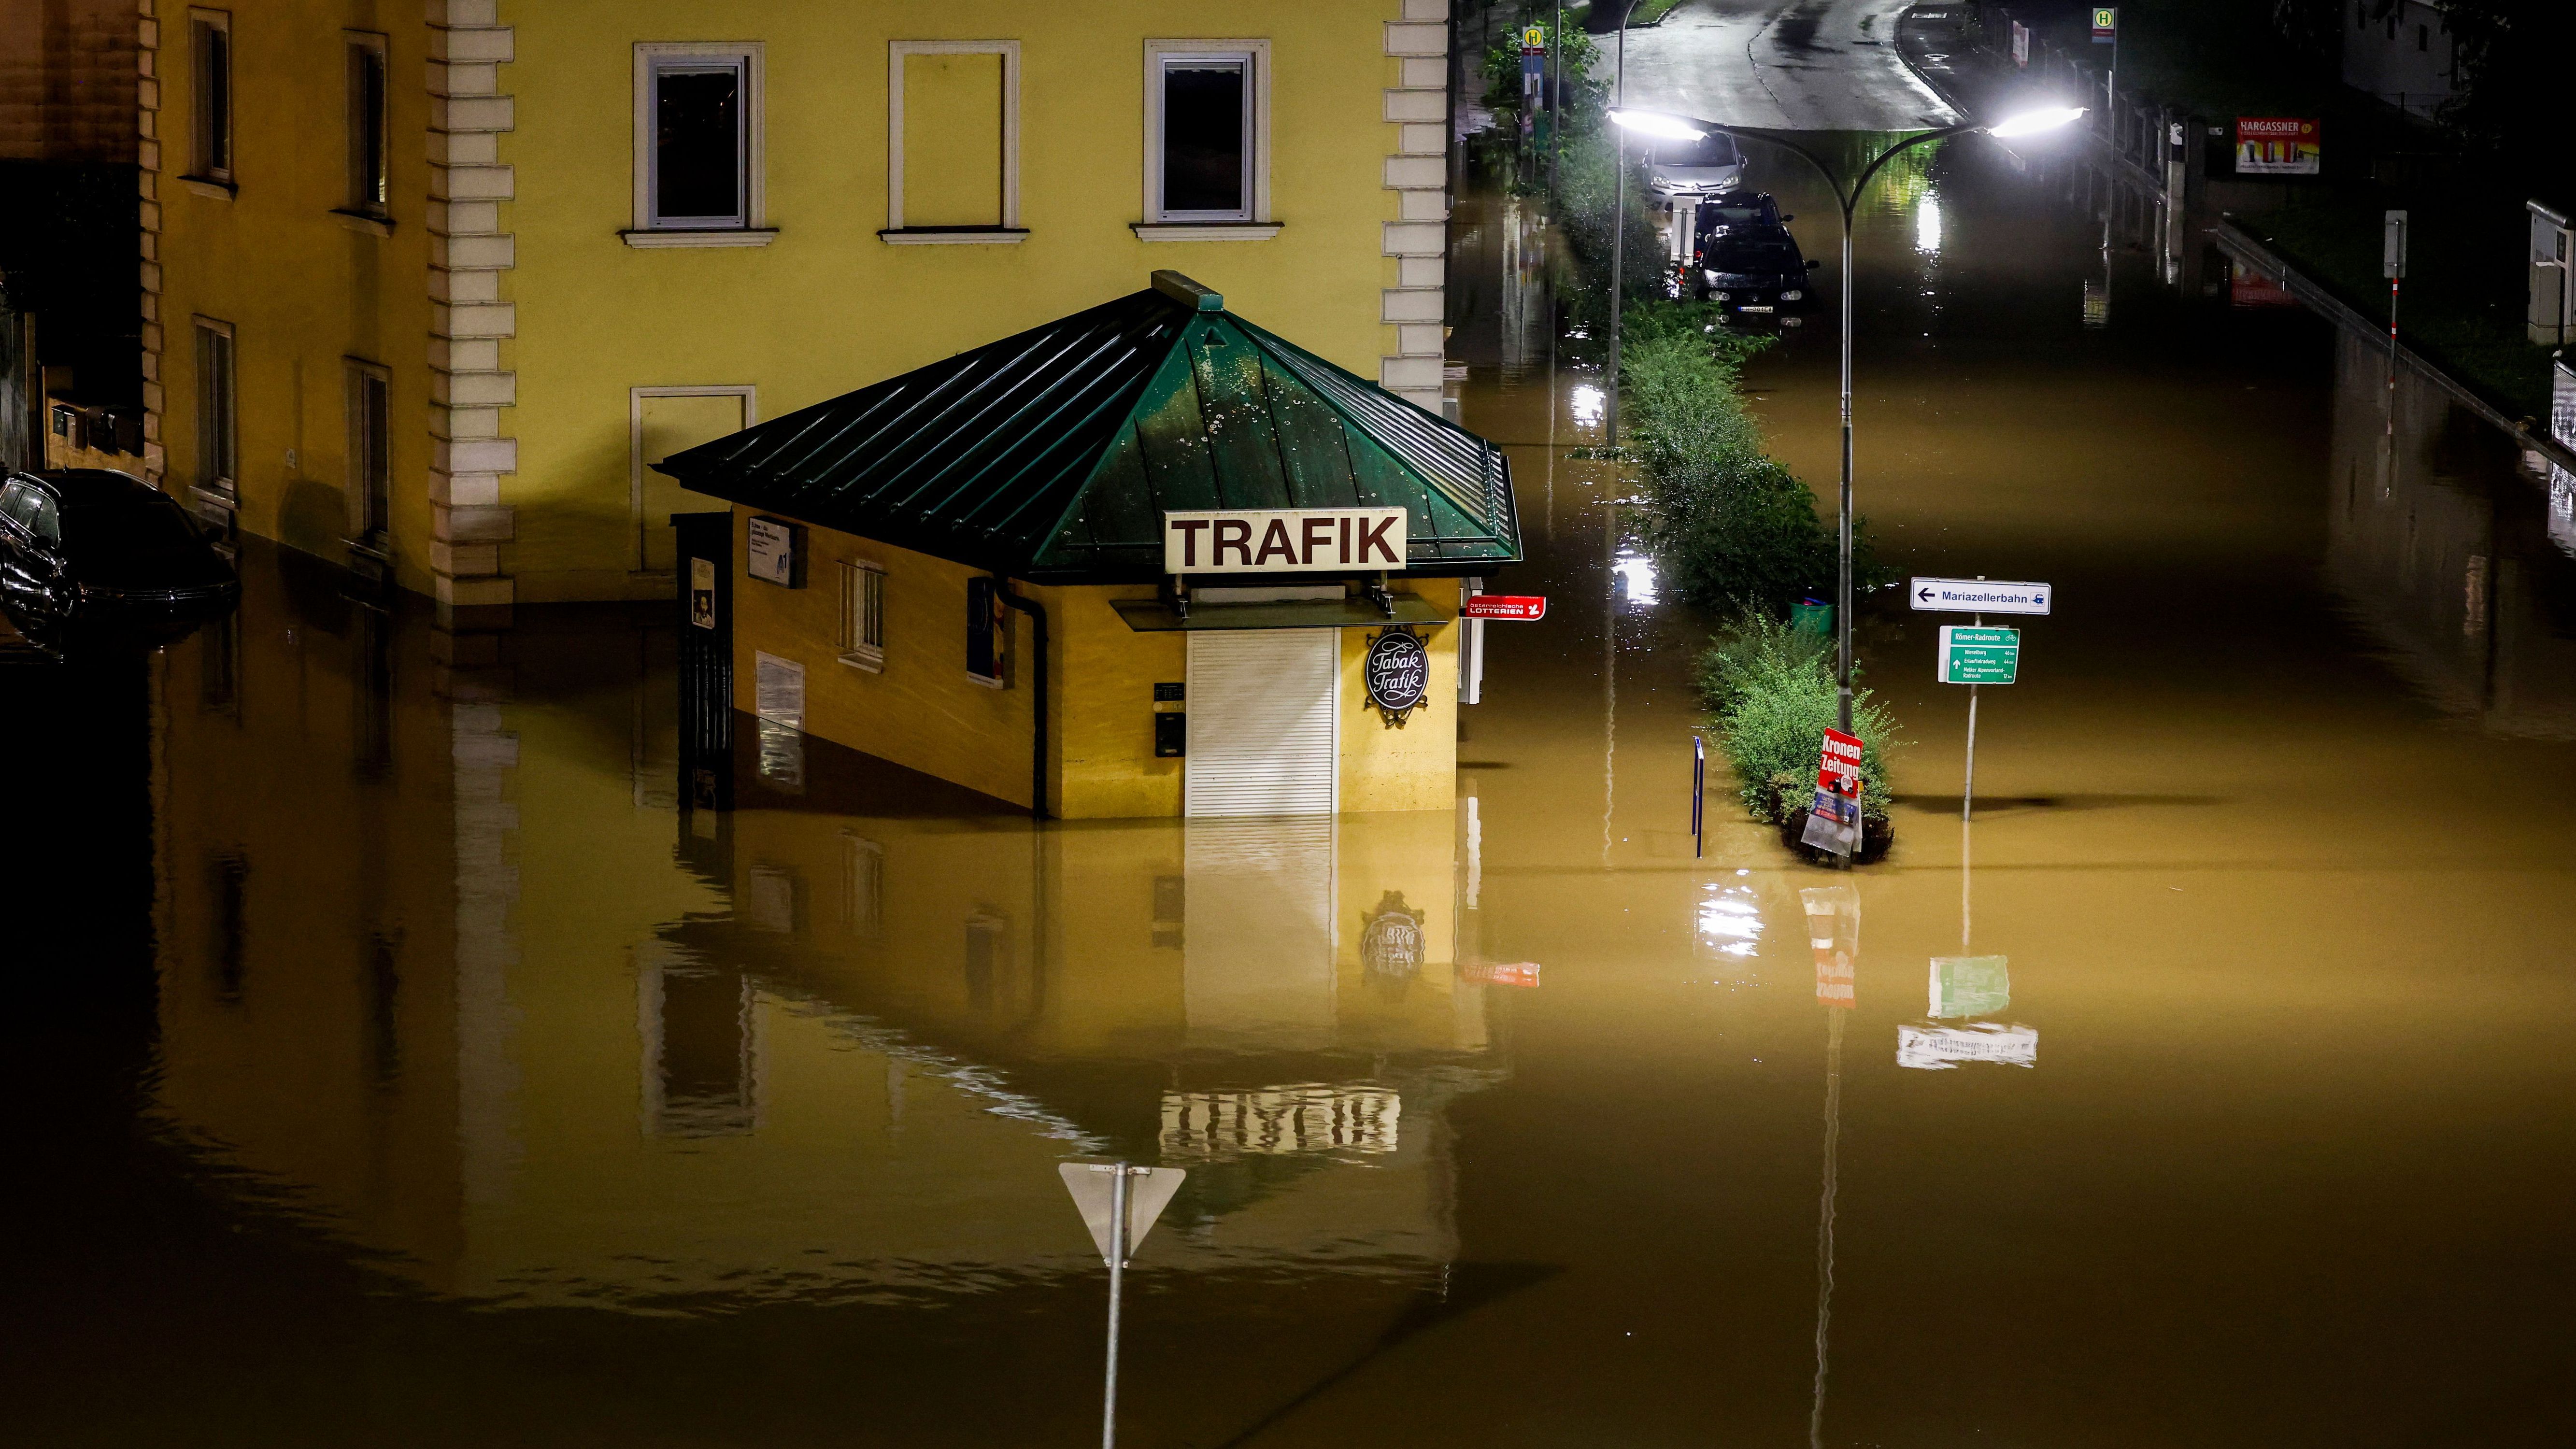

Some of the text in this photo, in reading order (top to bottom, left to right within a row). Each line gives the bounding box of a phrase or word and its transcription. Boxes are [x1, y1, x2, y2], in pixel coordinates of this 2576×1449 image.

[2100, 14, 2108, 24] H
[1529, 32, 1537, 43] H
[2241, 121, 2298, 131] HARGASSNER
[1171, 517, 1400, 567] TRAFIK
[777, 553, 787, 574] A1
[1942, 591, 2027, 603] Mariazellerbahn
[1955, 633, 2001, 641] Römer-Radroute
[1372, 642, 1423, 673] Tabak
[1373, 669, 1423, 700] Trafik
[1822, 735, 1861, 760] Kronen
[1821, 754, 1859, 780] Zeitung
